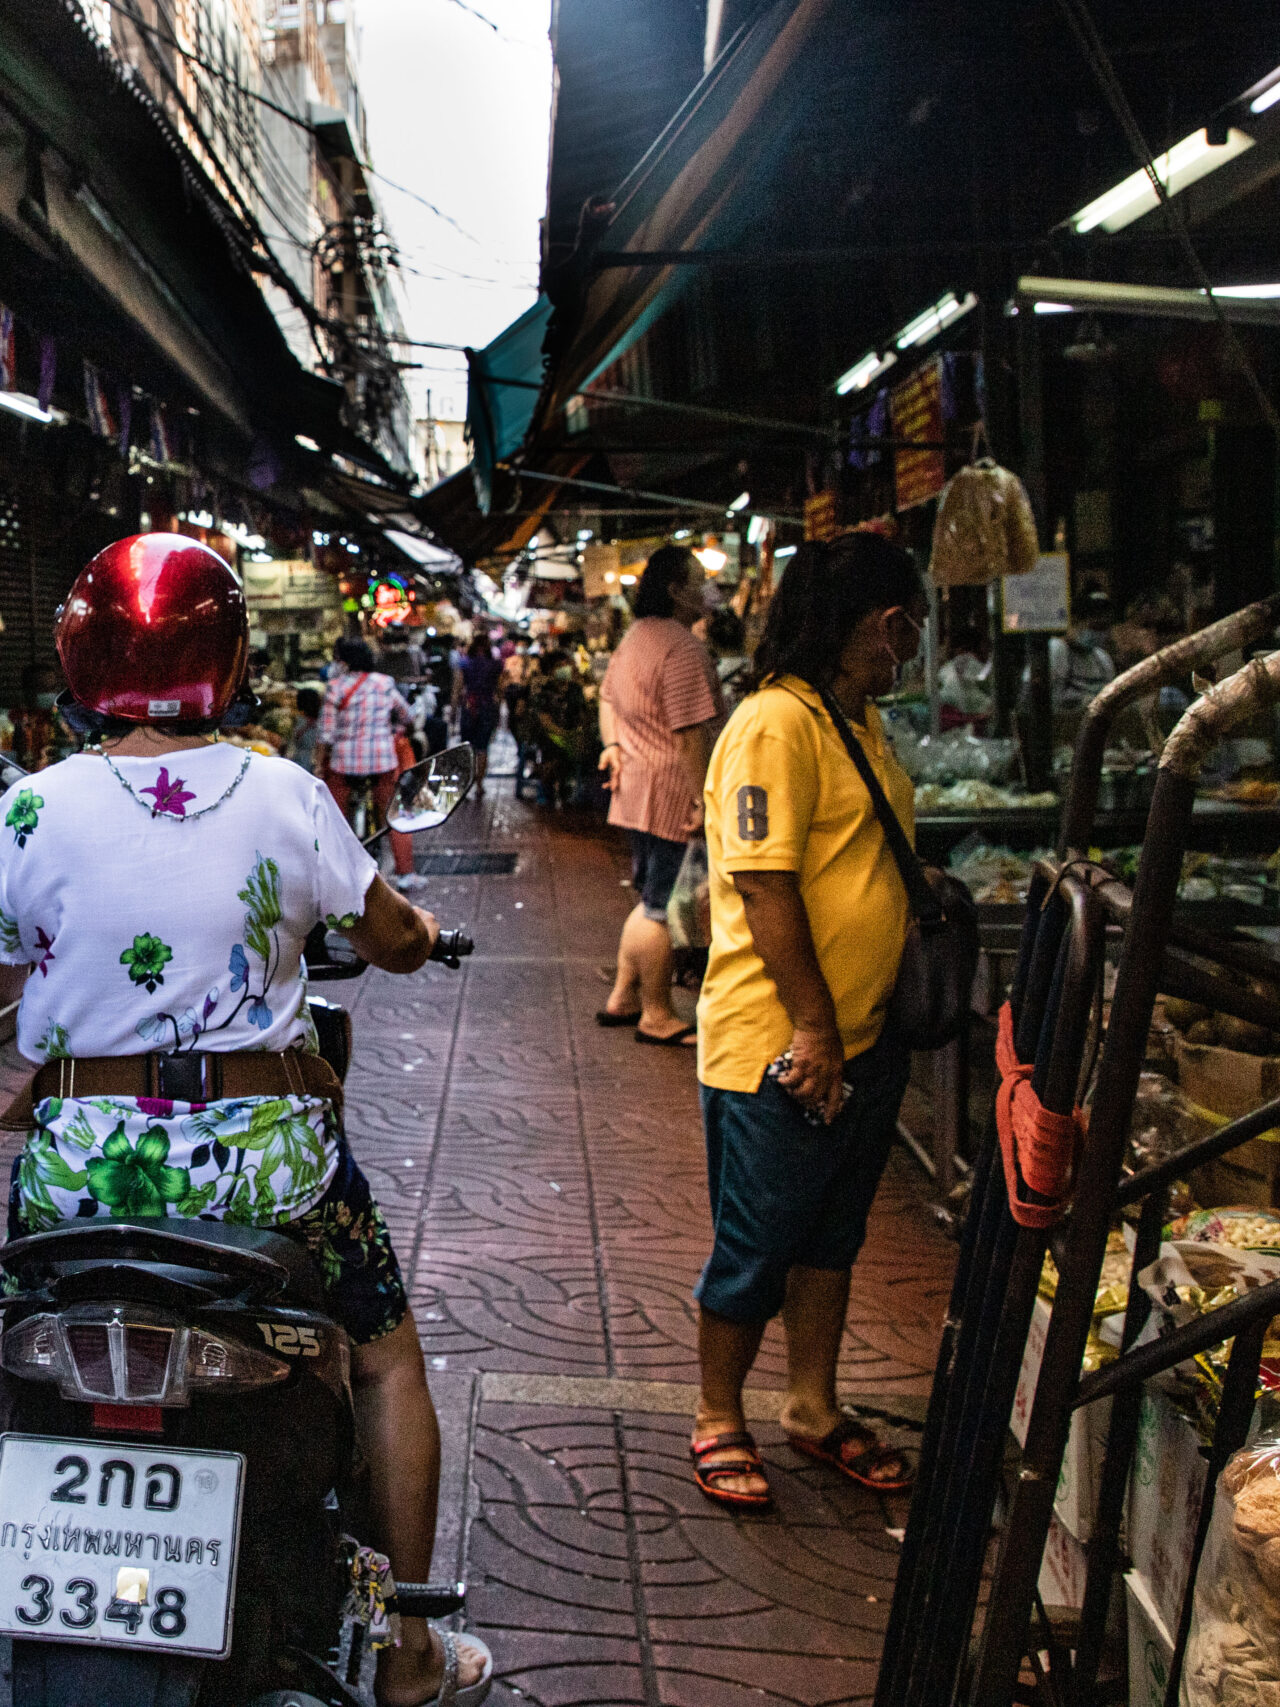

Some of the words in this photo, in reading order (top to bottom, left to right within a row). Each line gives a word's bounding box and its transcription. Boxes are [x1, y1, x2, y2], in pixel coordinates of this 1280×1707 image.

[736, 785, 769, 841] 8
[256, 1322, 321, 1357] 125
[50, 1454, 183, 1512] 2กอ
[0, 1520, 222, 1567] กรุงเทพมหานคร
[15, 1572, 188, 1639] 3348
